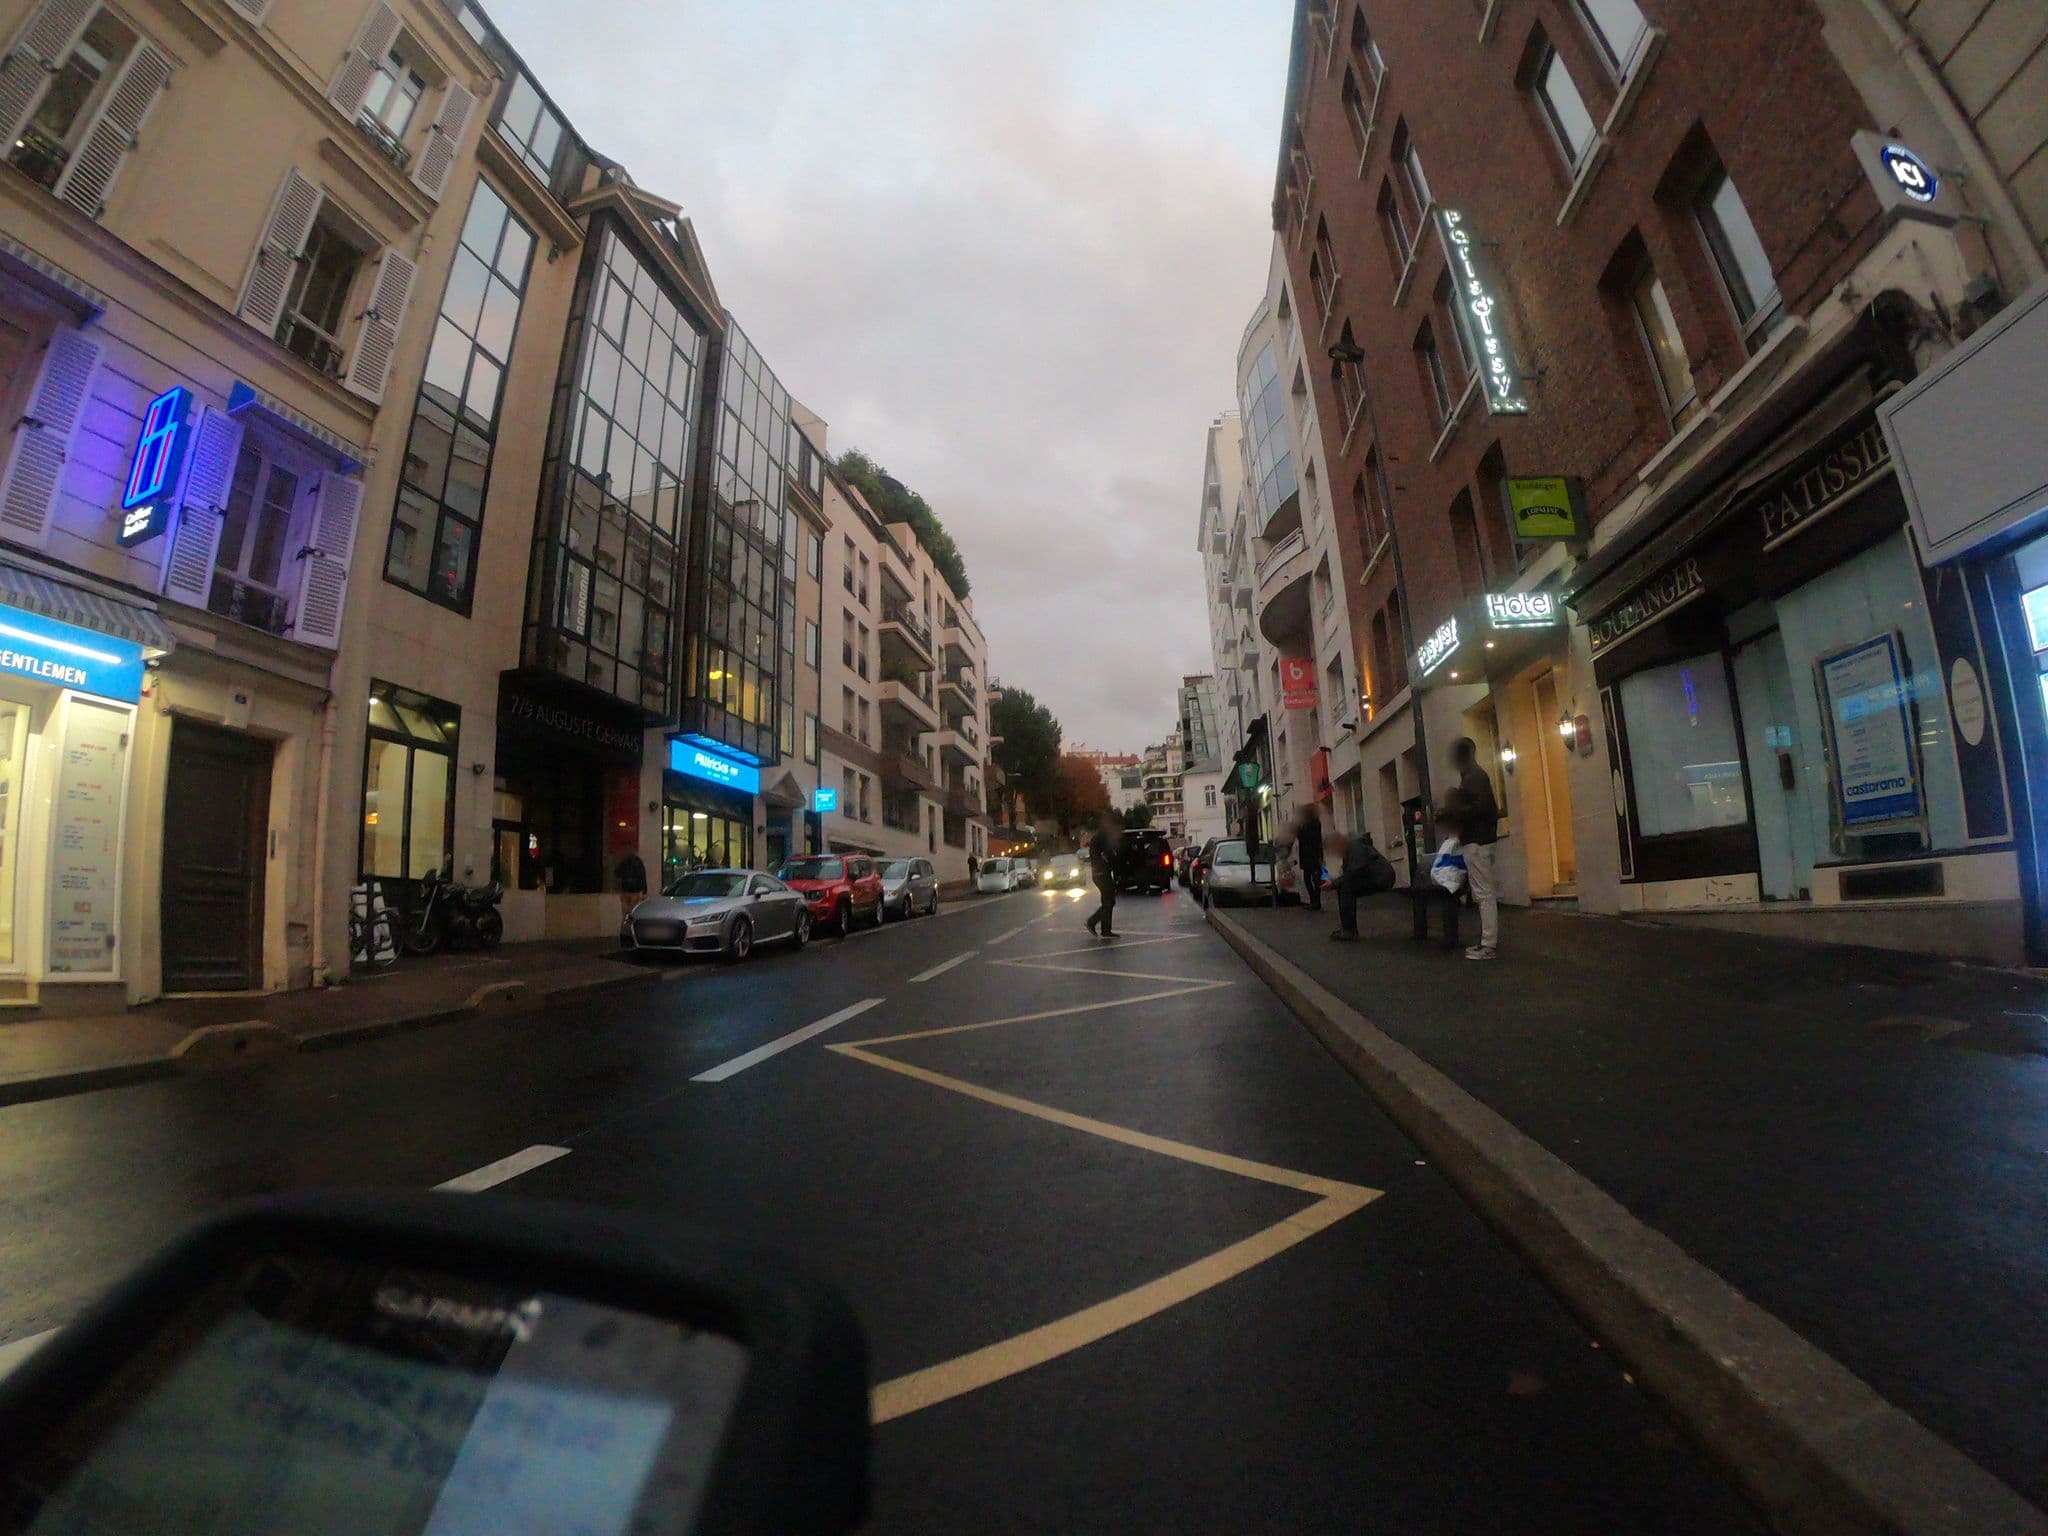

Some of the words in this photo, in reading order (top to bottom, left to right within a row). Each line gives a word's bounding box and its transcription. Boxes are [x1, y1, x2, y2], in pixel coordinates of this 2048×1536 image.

[1890, 159, 1926, 188] ICI
[1590, 558, 1703, 650] BOULANGER
[0, 650, 87, 685] ENTLEMEN
[1846, 777, 1906, 796] castorama
